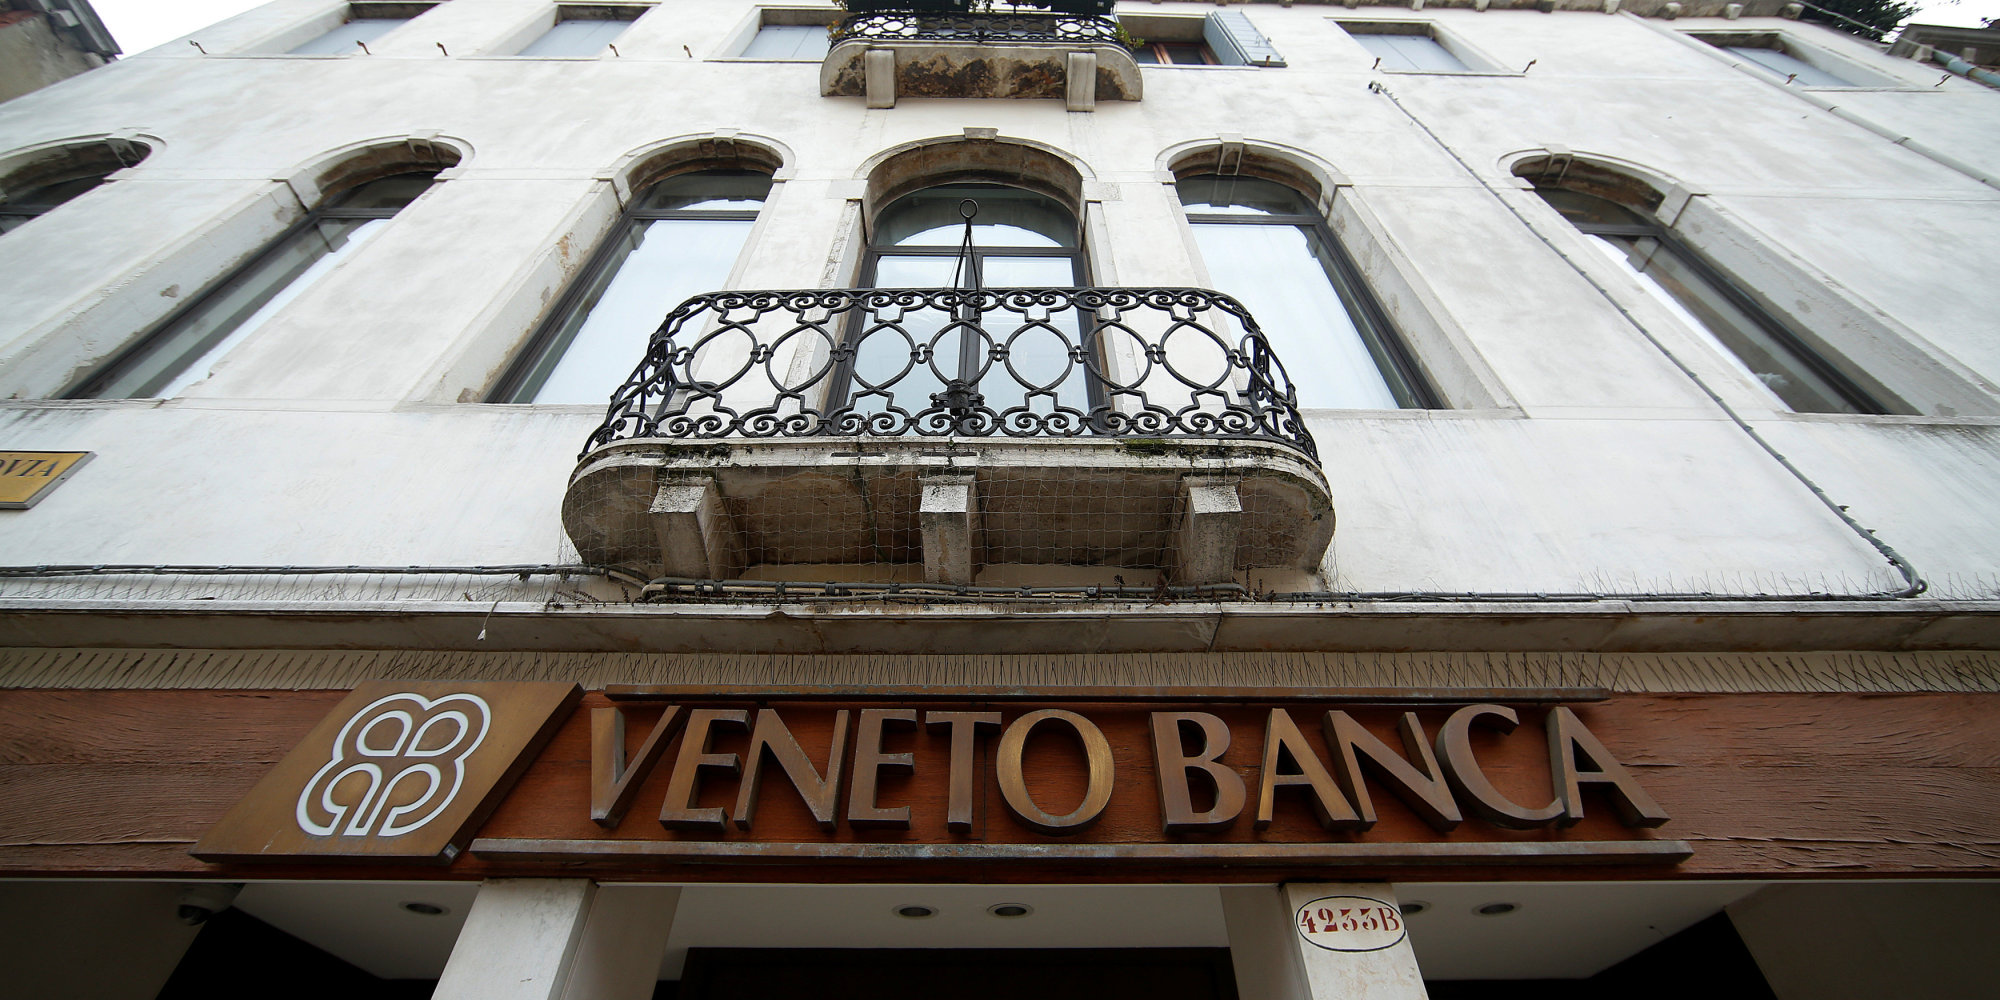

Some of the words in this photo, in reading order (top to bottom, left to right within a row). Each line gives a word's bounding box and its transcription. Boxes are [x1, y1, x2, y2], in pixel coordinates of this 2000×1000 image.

[590, 705, 1115, 836] VENETO
[1148, 704, 1671, 834] BANCA
[1300, 907, 1400, 934] 4233B
